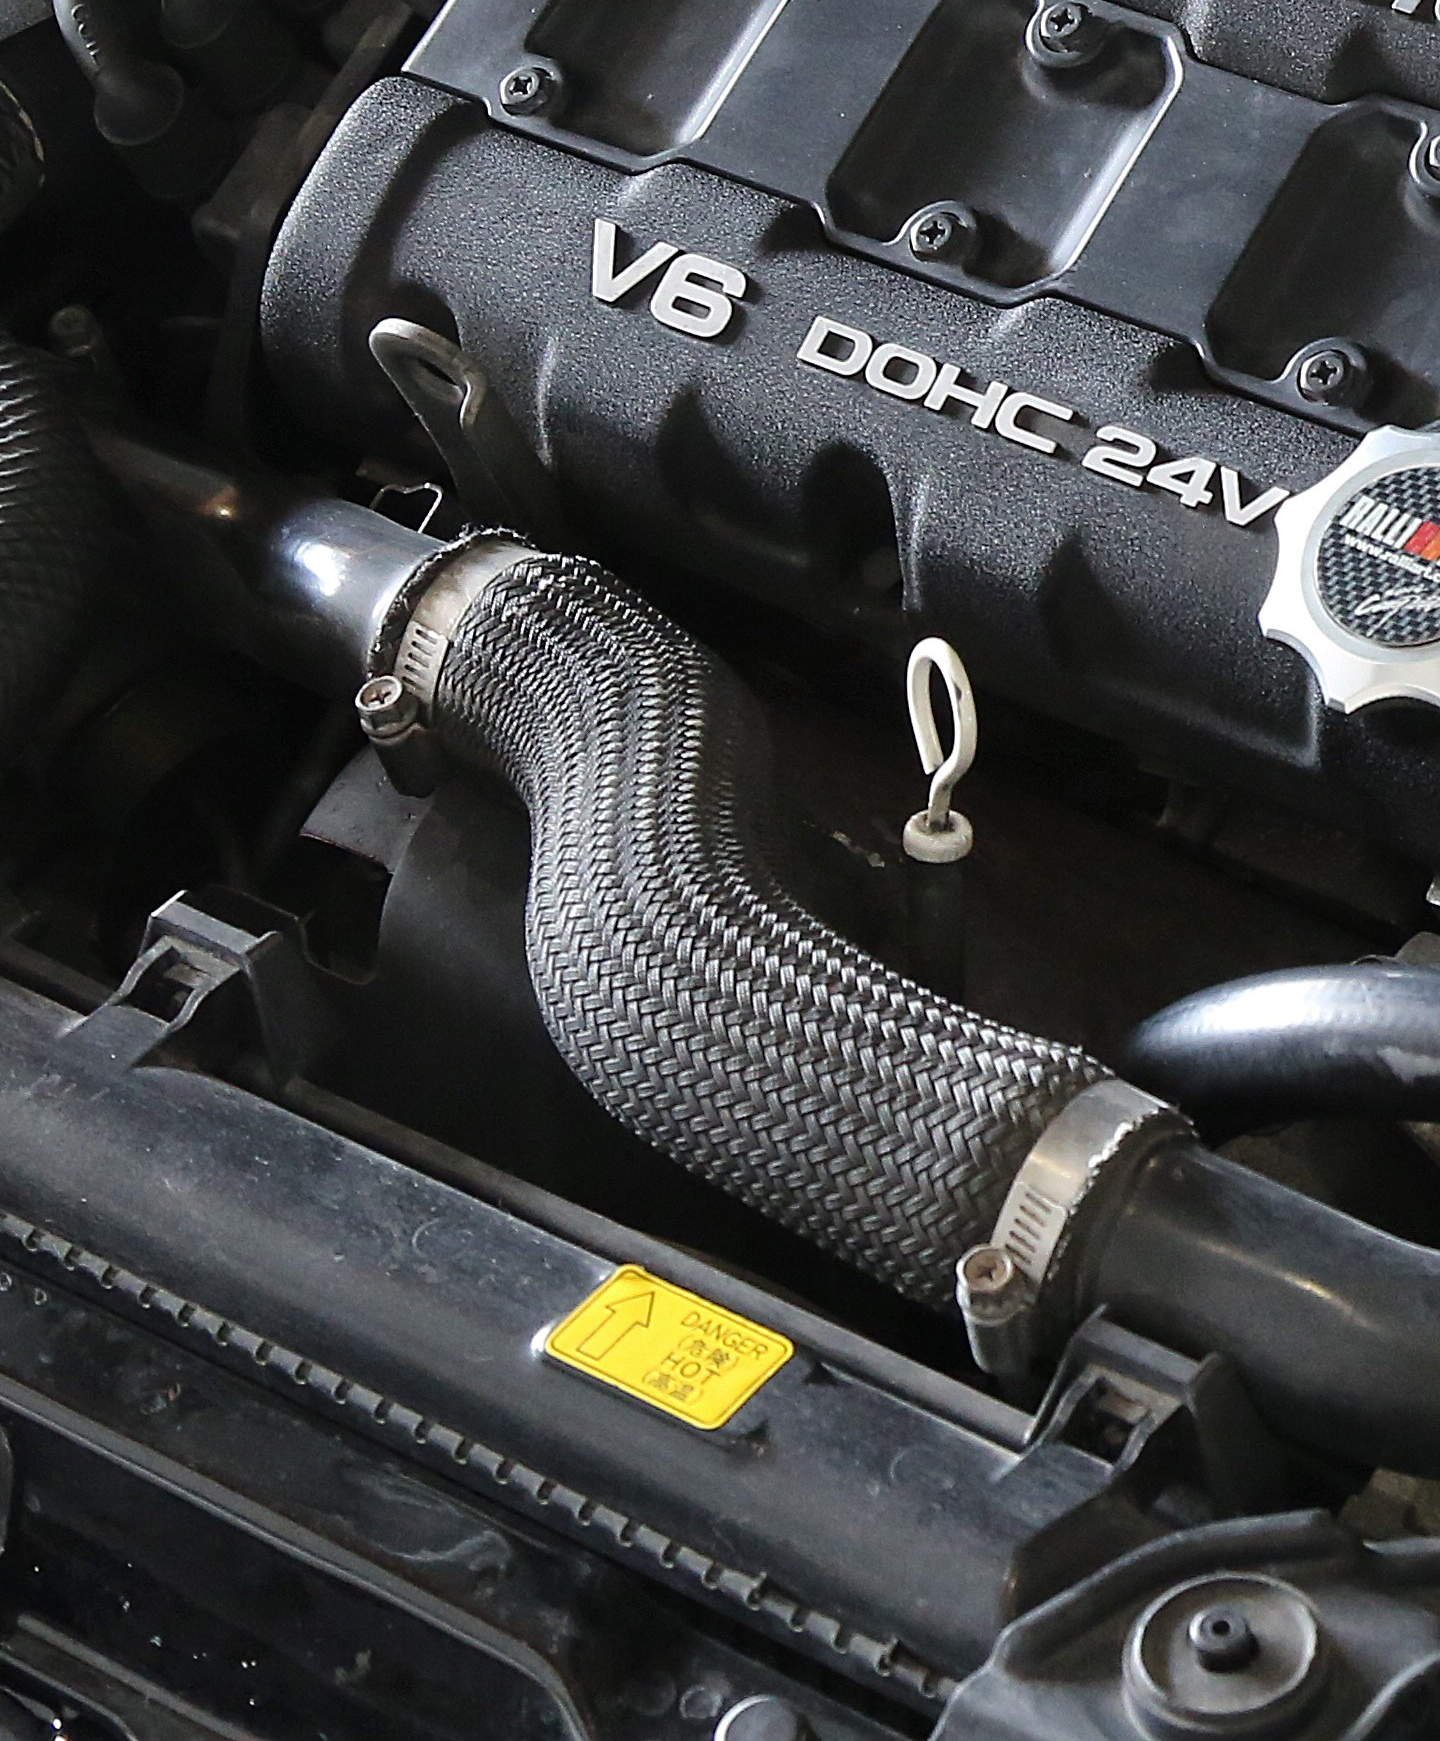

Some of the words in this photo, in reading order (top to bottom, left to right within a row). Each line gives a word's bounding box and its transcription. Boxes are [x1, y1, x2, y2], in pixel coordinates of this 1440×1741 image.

[589, 218, 747, 340] V6
[797, 314, 1074, 455] DOHC
[1082, 424, 1290, 526] 24V
[661, 1352, 721, 1385] HOT
[680, 1312, 768, 1360] DANGER
